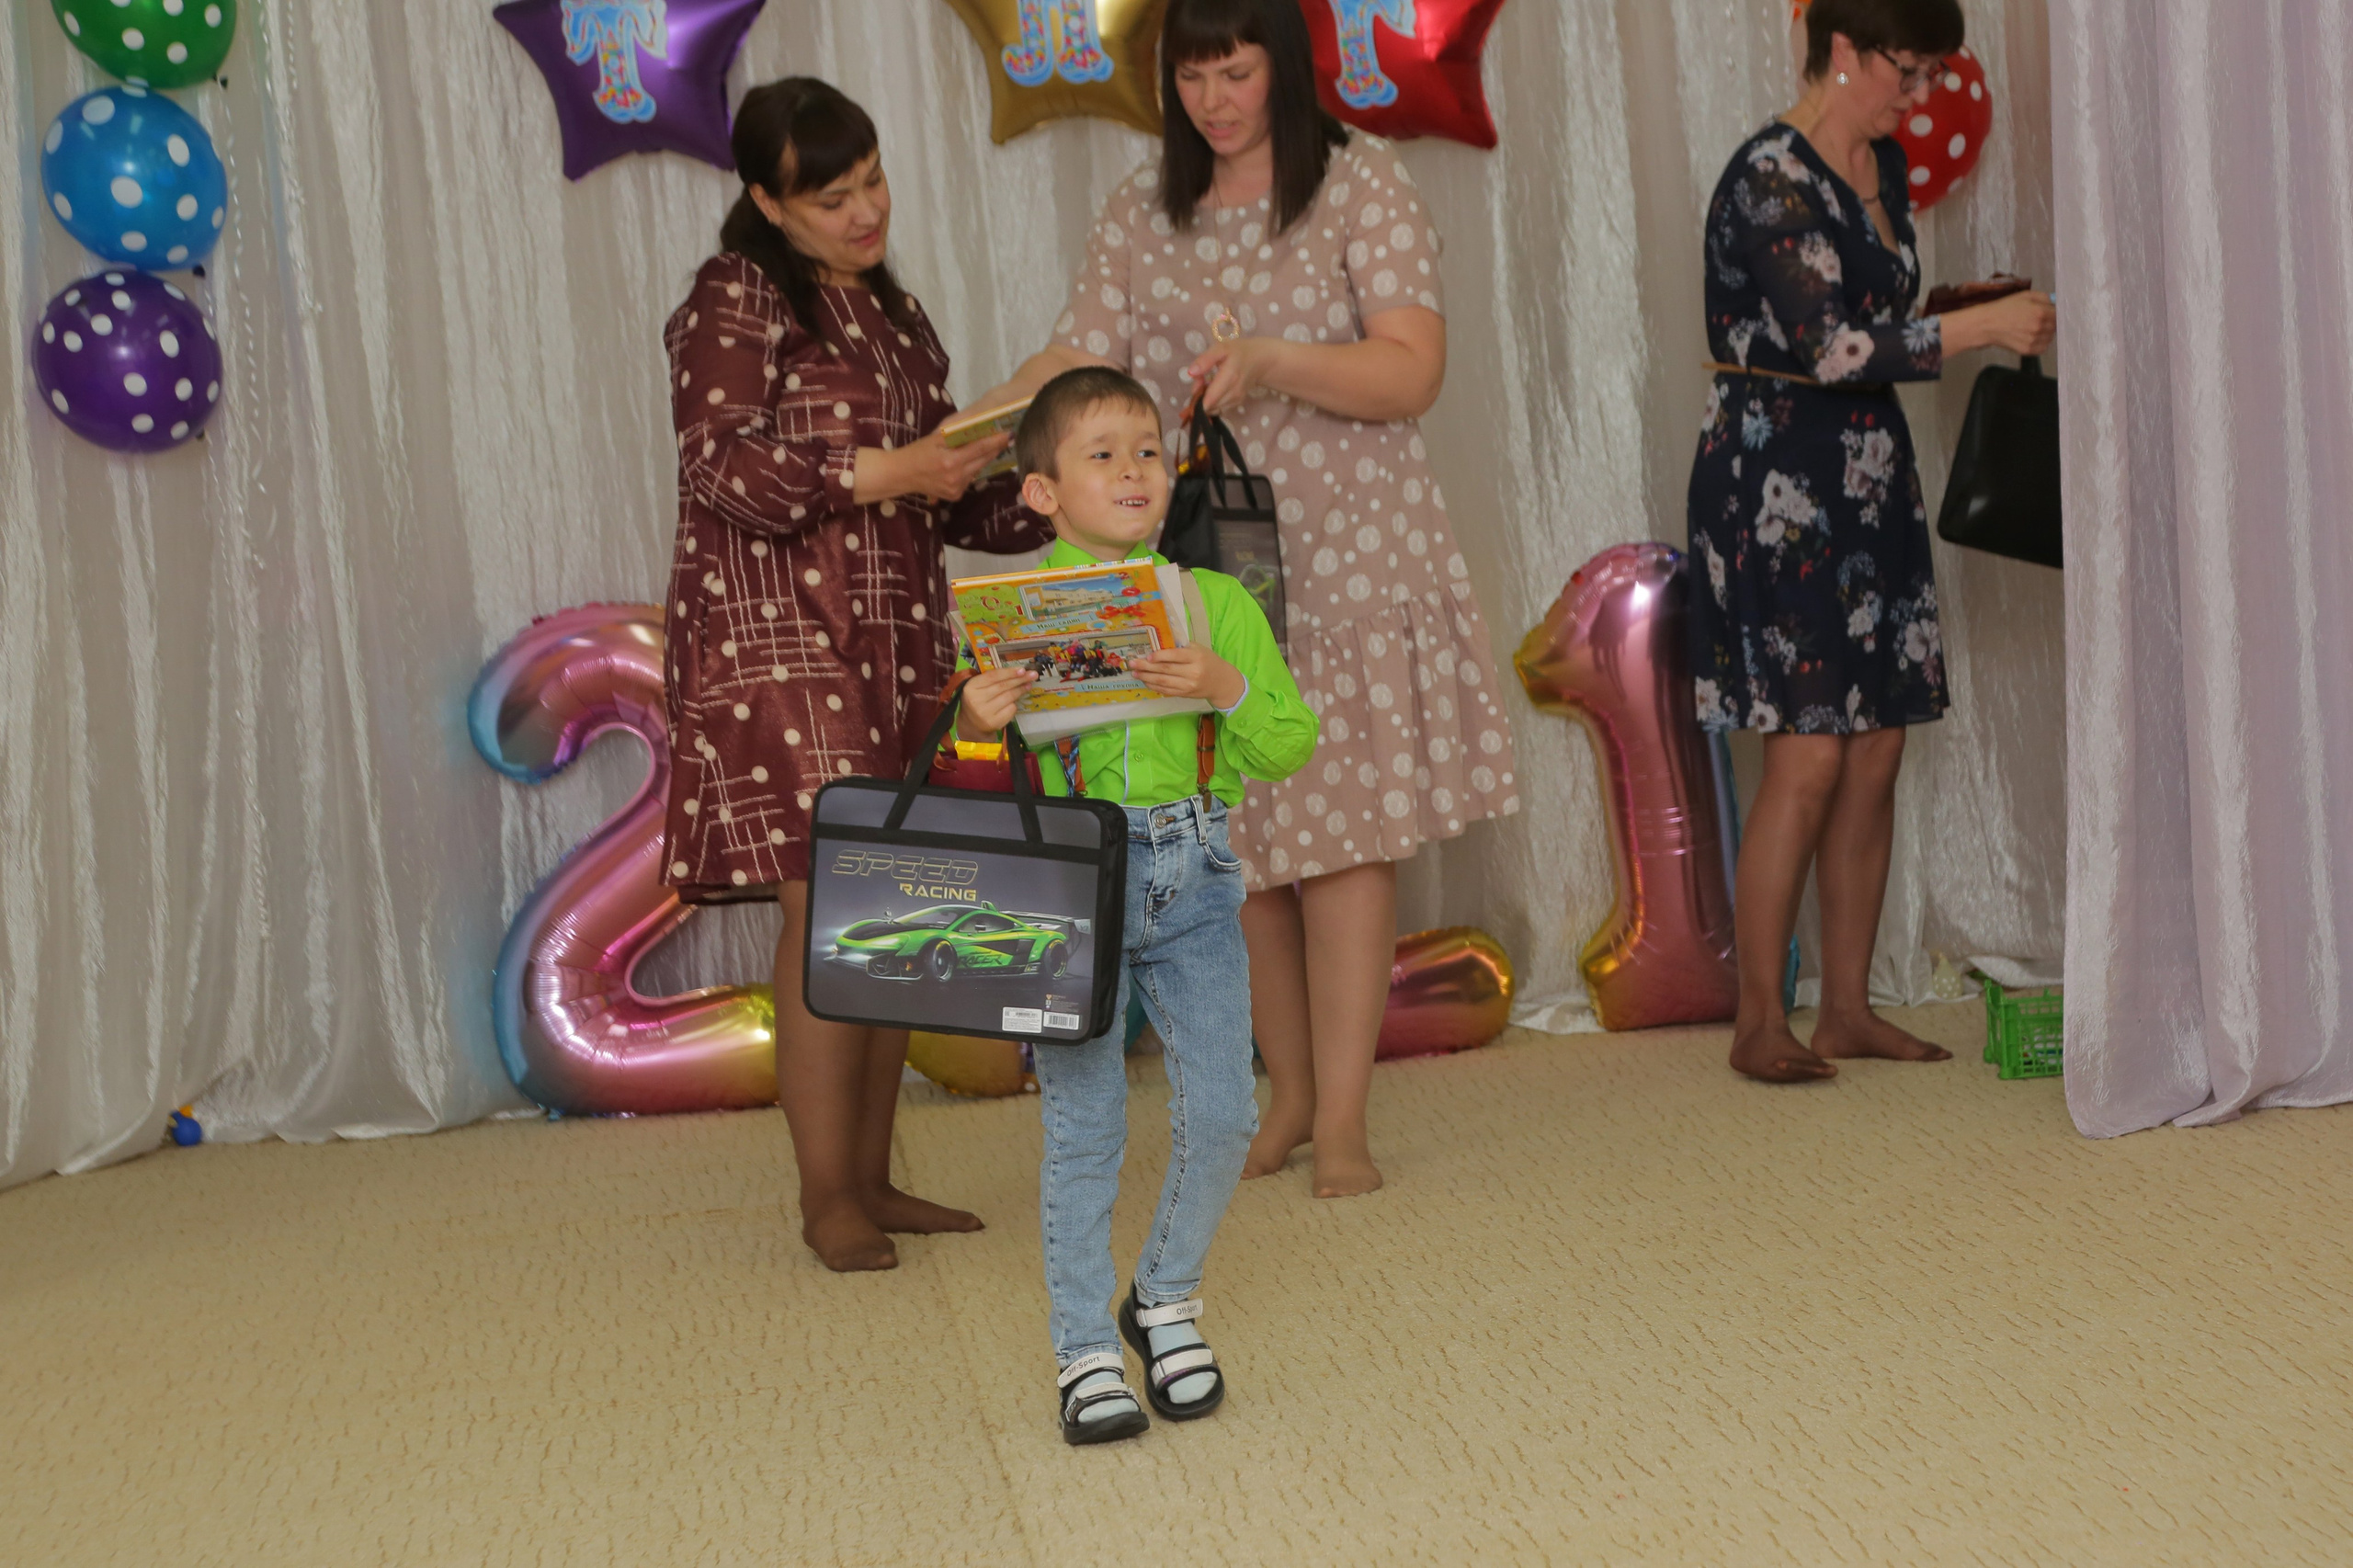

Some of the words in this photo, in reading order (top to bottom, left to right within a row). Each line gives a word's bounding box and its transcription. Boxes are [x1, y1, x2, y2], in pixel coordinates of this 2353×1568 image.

[832, 848, 979, 886] SPEED
[899, 882, 977, 903] RACING
[1066, 1356, 1100, 1377] Off-Sport
